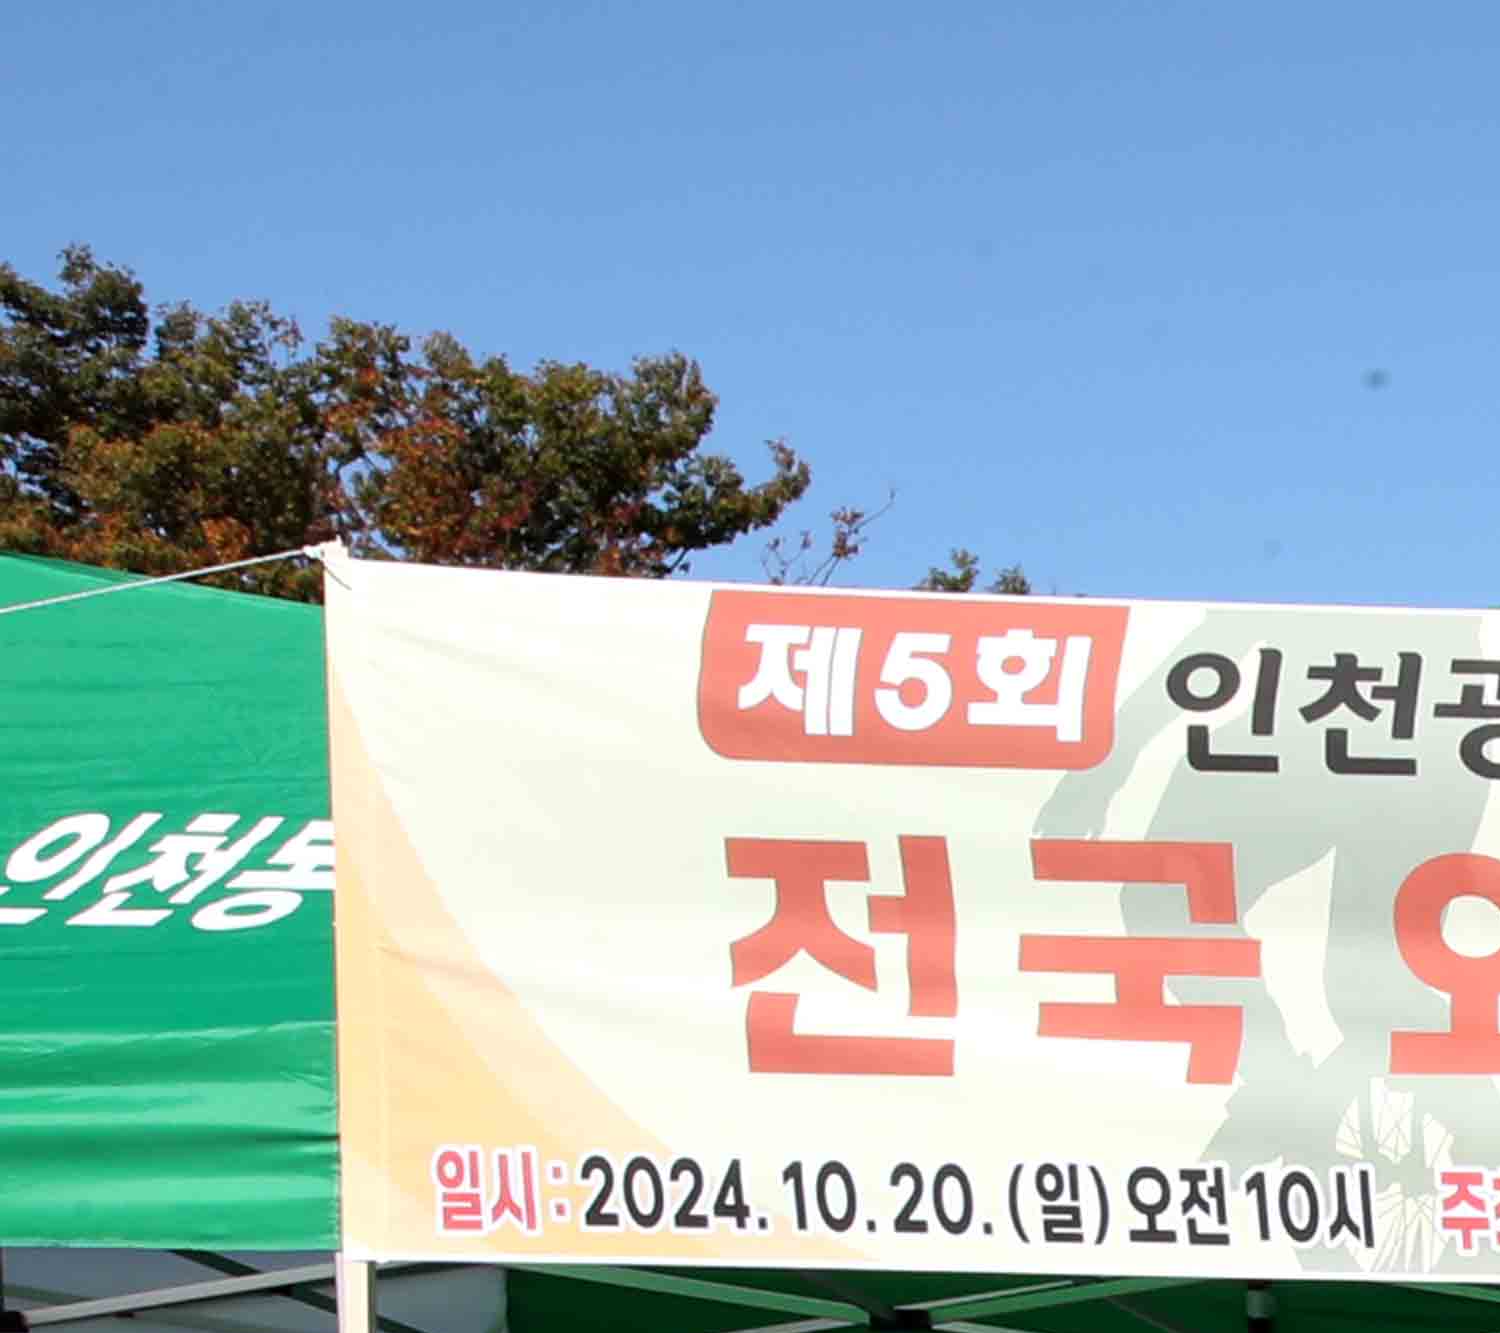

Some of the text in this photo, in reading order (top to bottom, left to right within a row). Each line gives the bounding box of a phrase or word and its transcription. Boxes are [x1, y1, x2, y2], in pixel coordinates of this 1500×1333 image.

[737, 623, 1093, 742] 제5회
[724, 834, 1262, 1085] 전국
[1126, 1166, 1231, 1246] 오전
[1245, 1170, 1375, 1249] 10시
